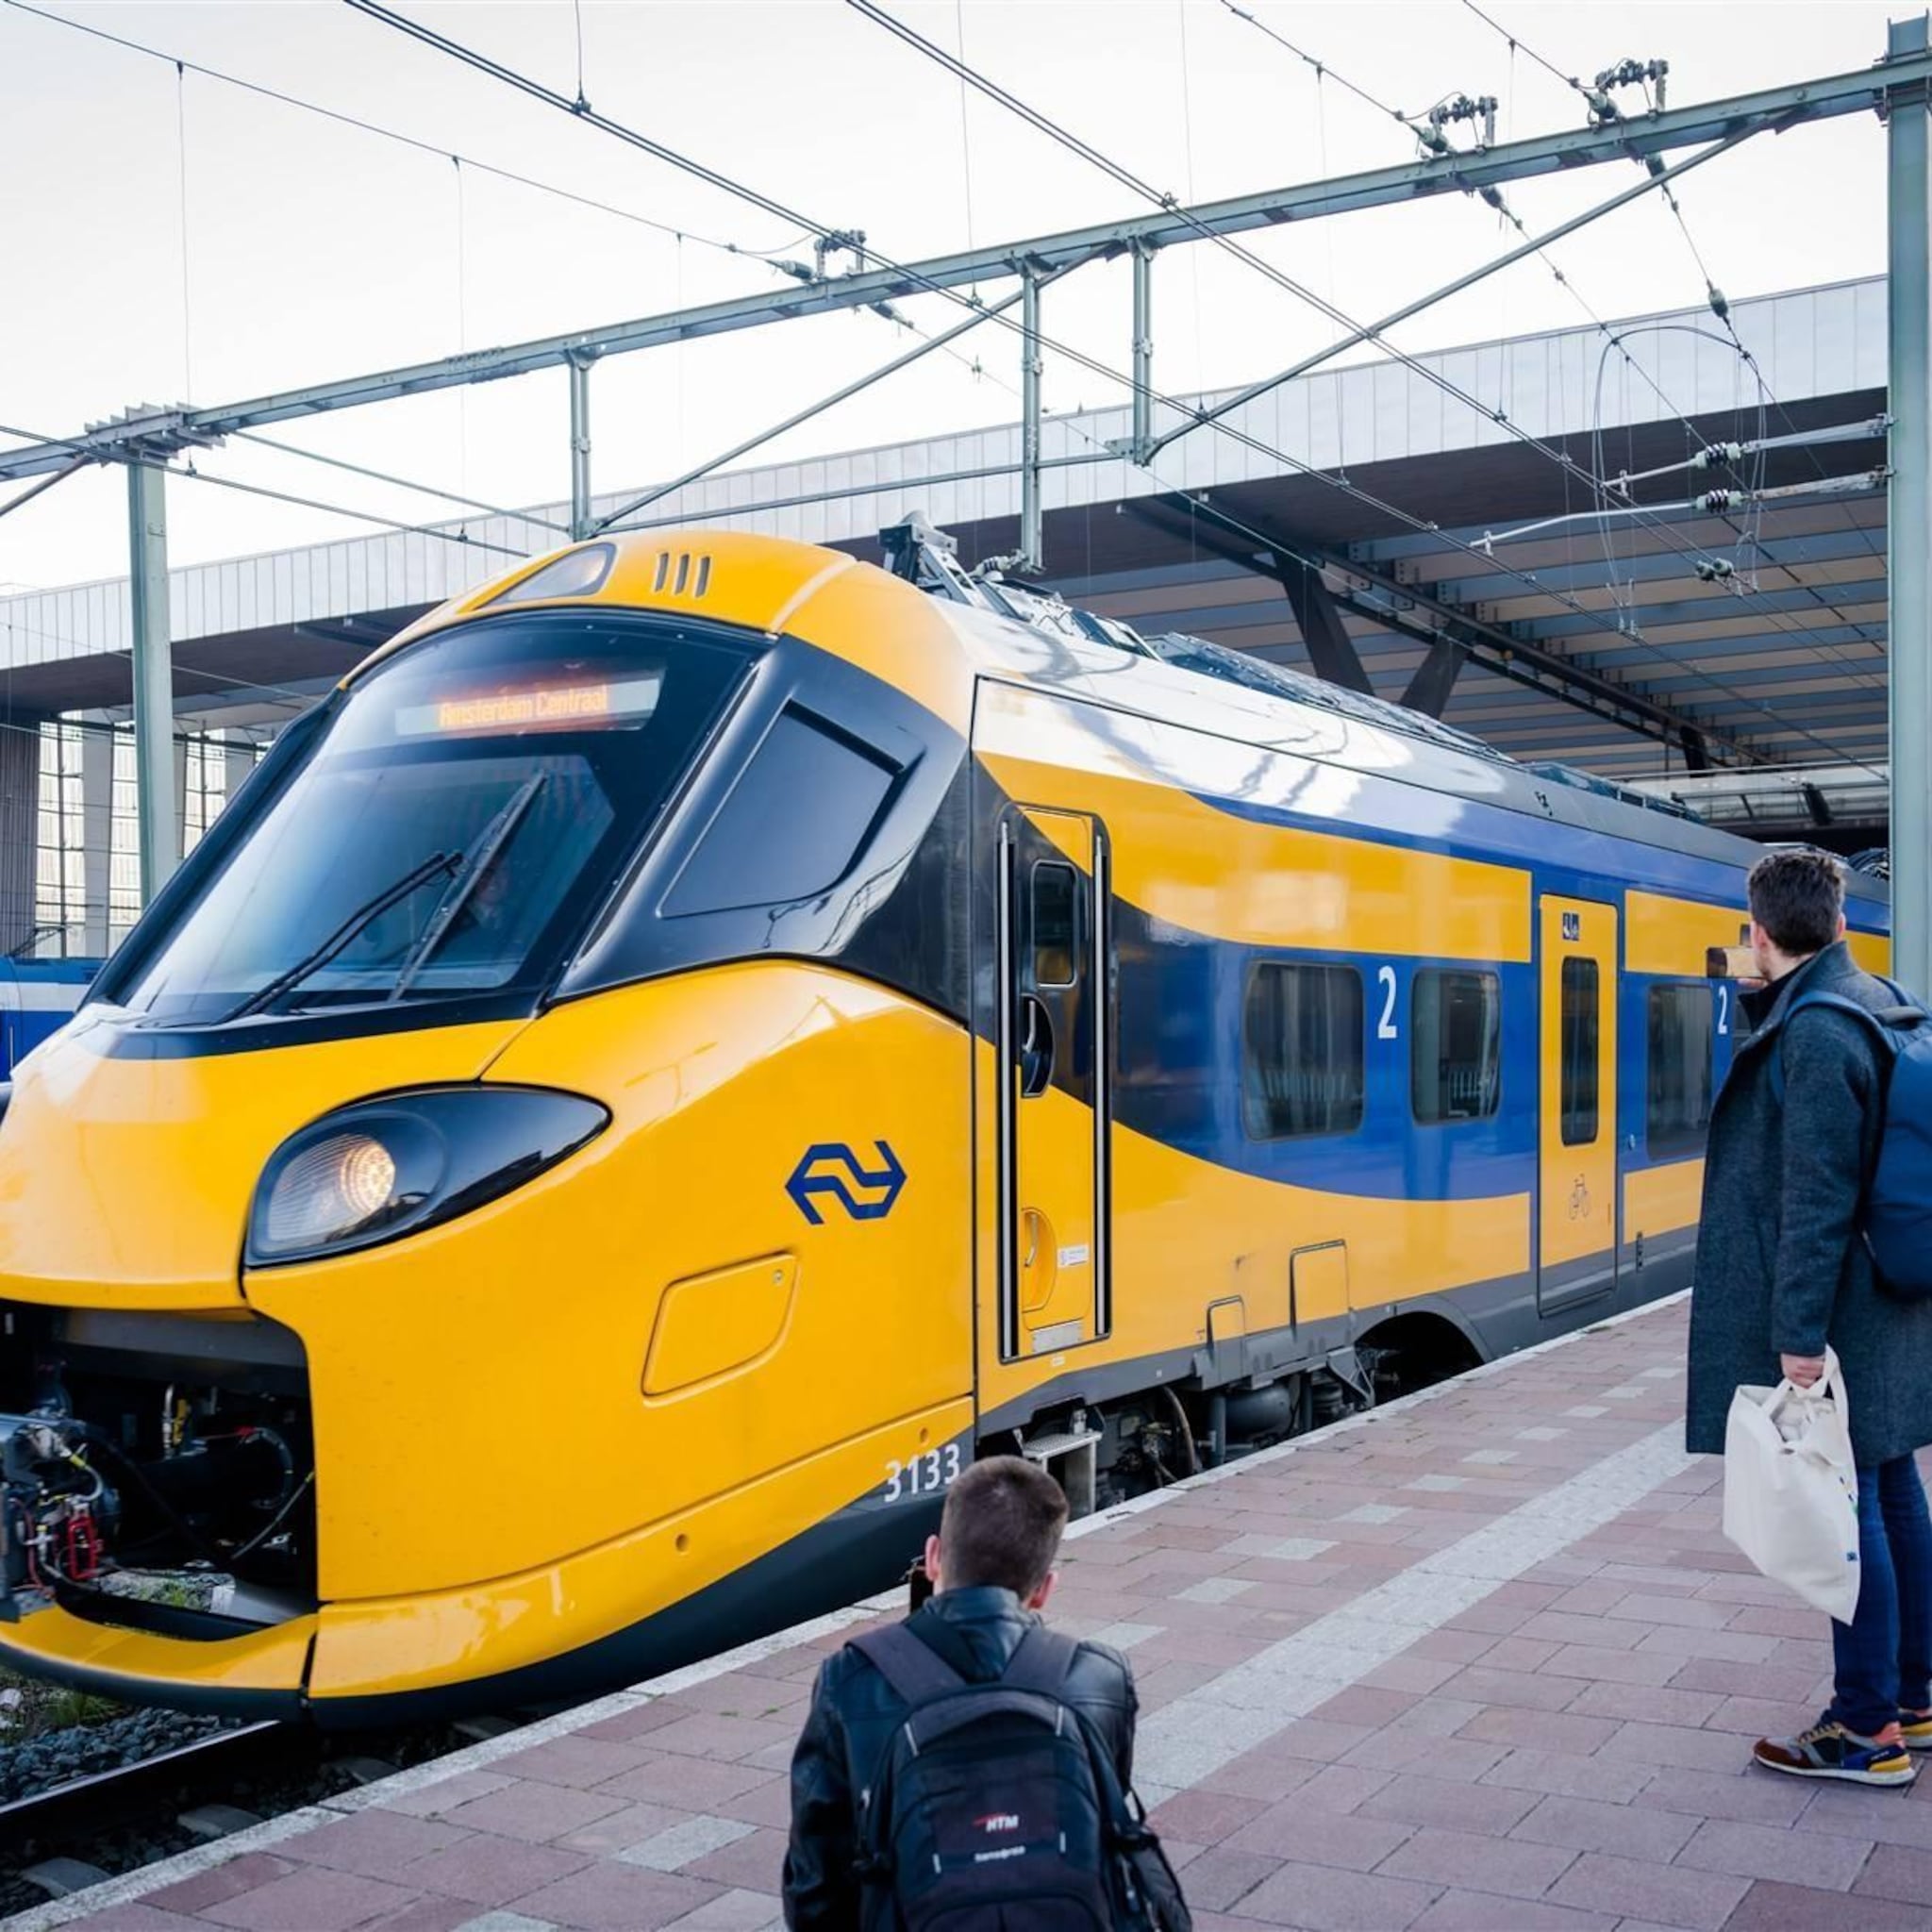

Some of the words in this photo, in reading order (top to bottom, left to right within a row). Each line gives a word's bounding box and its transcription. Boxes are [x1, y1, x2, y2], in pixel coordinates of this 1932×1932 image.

[439, 696, 533, 728] Amsterdam
[535, 683, 608, 717] Centraal
[1377, 965, 1397, 1039] 2
[1718, 985, 1728, 1035] 2
[884, 1442, 960, 1503] 3133
